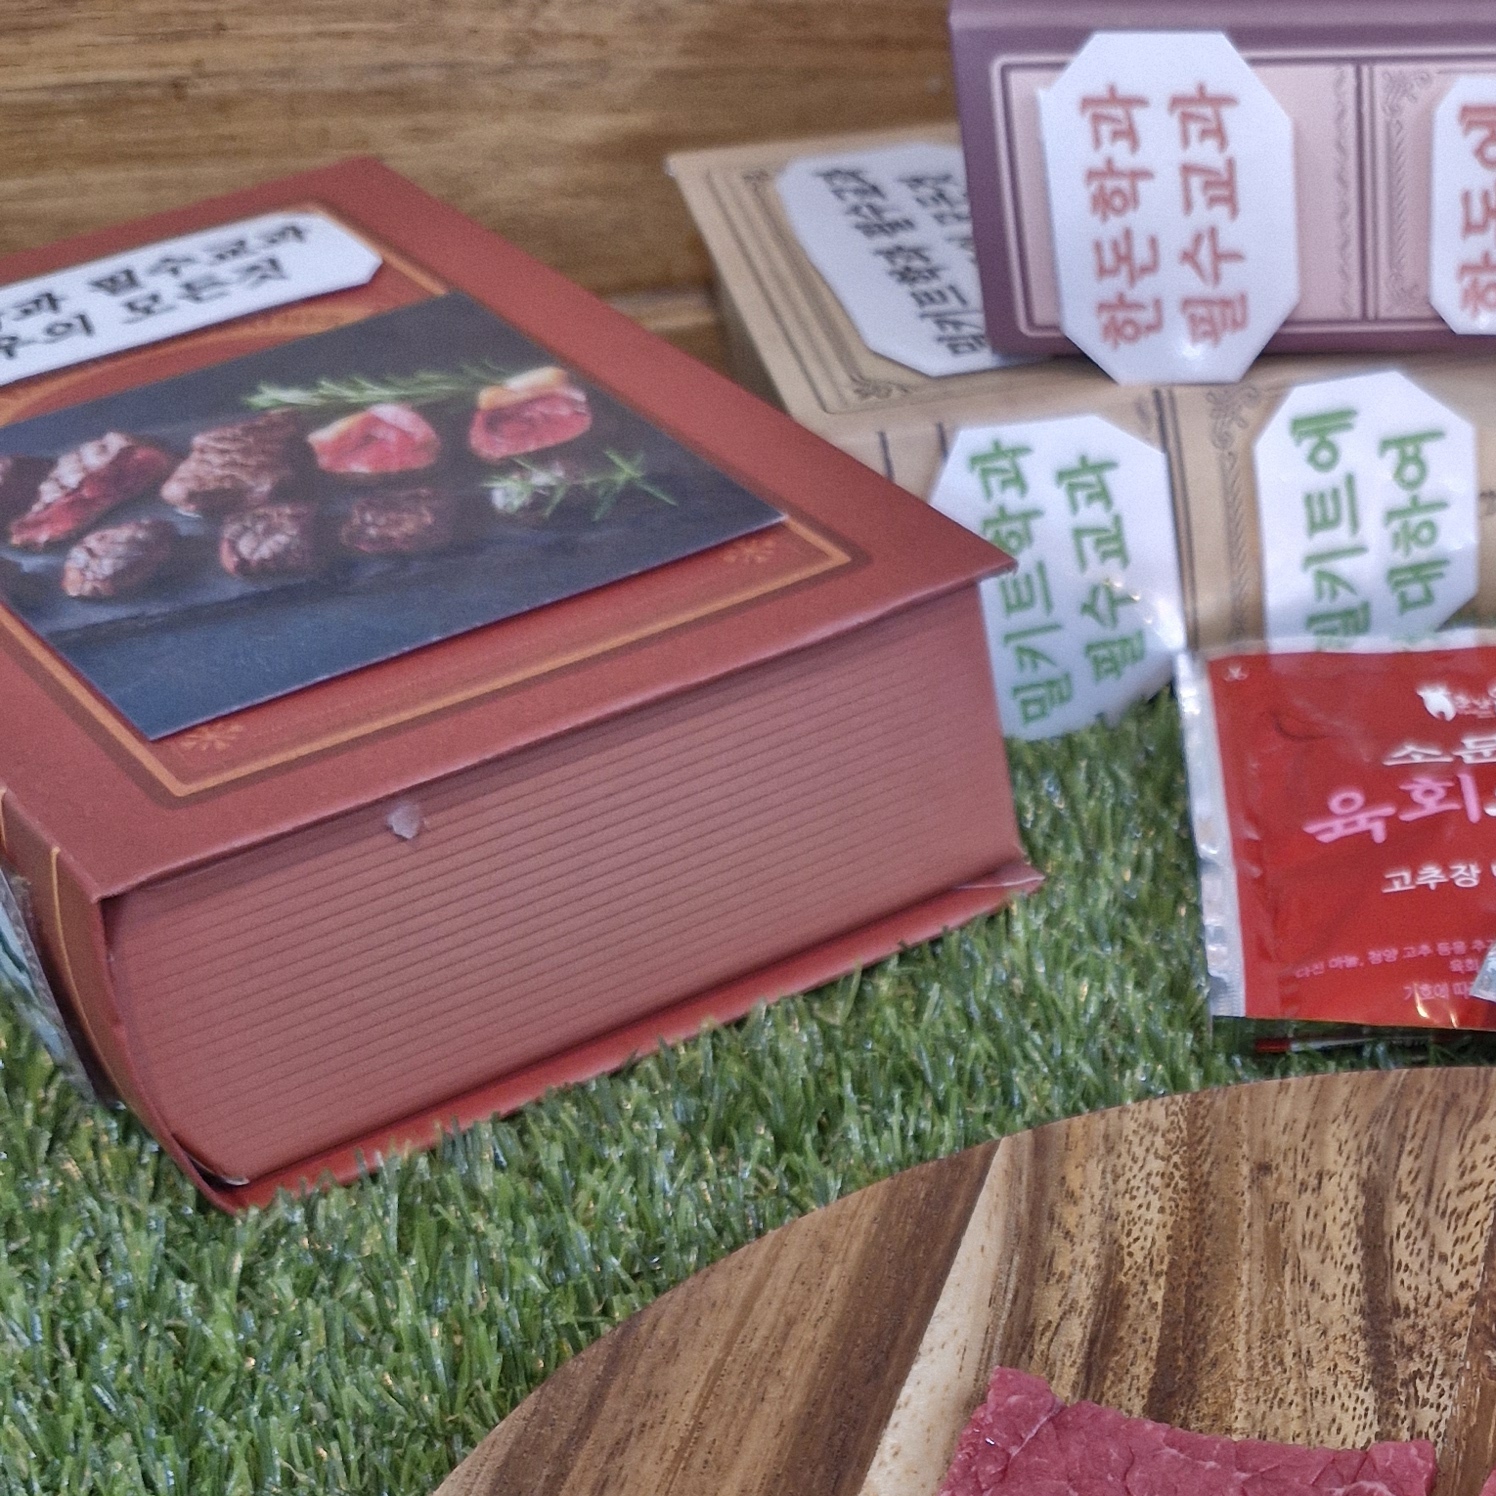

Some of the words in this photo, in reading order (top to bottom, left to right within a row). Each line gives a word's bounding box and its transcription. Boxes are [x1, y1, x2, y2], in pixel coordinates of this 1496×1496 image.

[1080, 82, 1164, 350] 한돈학과
[1167, 82, 1247, 347] 필수교과
[969, 438, 1072, 728] 밀키트학과
[1056, 455, 1146, 683] 필수교과
[1291, 408, 1371, 650] 밀키트에
[1378, 430, 1451, 616] 대하여
[1381, 863, 1481, 893] 고추장
